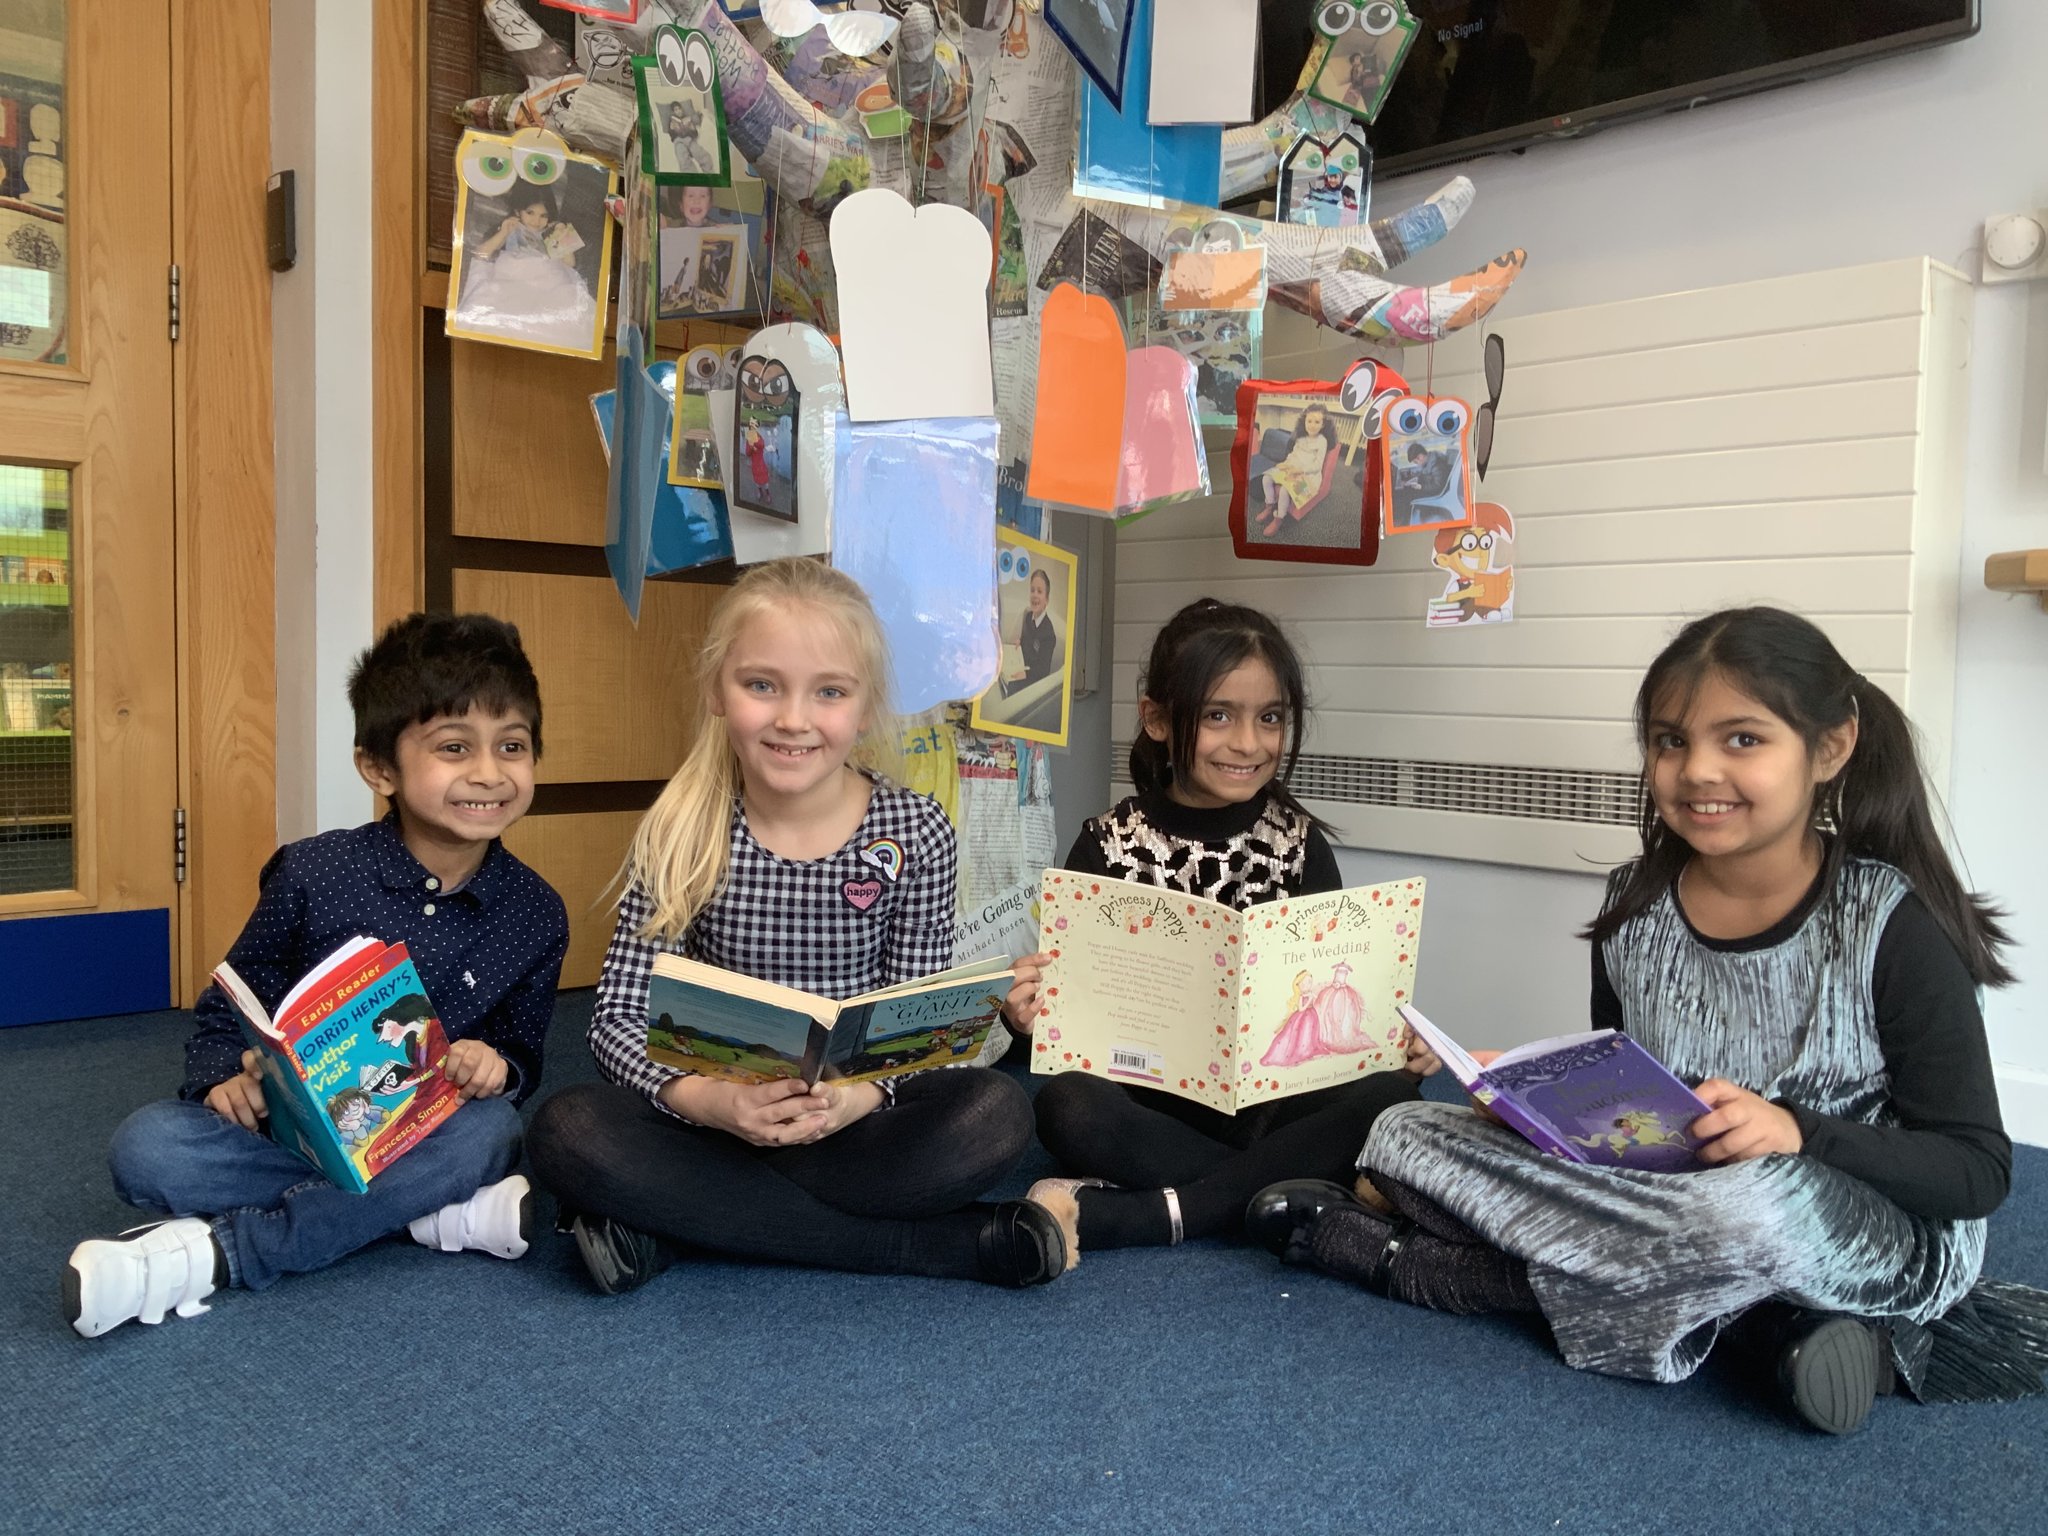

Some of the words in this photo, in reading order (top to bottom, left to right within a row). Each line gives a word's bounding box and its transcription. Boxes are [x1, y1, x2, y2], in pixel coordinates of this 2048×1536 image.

[1437, 29, 1450, 42] No
[1453, 18, 1483, 38] Signal
[1085, 227, 1121, 271] ALIEN
[996, 307, 1023, 316] Rescue
[846, 886, 879, 898] happy
[983, 893, 1024, 924] Going
[1024, 884, 1037, 899] on
[1099, 896, 1152, 927] Princess
[1149, 897, 1187, 936] Poppy
[1286, 900, 1336, 942] Princess
[1333, 895, 1371, 928] Poppy
[957, 933, 996, 962] Michael
[999, 917, 1025, 938] Rosen
[1282, 951, 1306, 965] The
[1312, 941, 1371, 959] Wedding
[301, 998, 334, 1027] Early
[337, 964, 380, 1000] Reader
[350, 970, 411, 1023] HENRY'S
[897, 996, 971, 1019] GIANT
[306, 1033, 358, 1079] Author
[313, 1060, 351, 1092] Visit
[368, 1122, 417, 1163] Francesca
[417, 1095, 449, 1122] Simon
